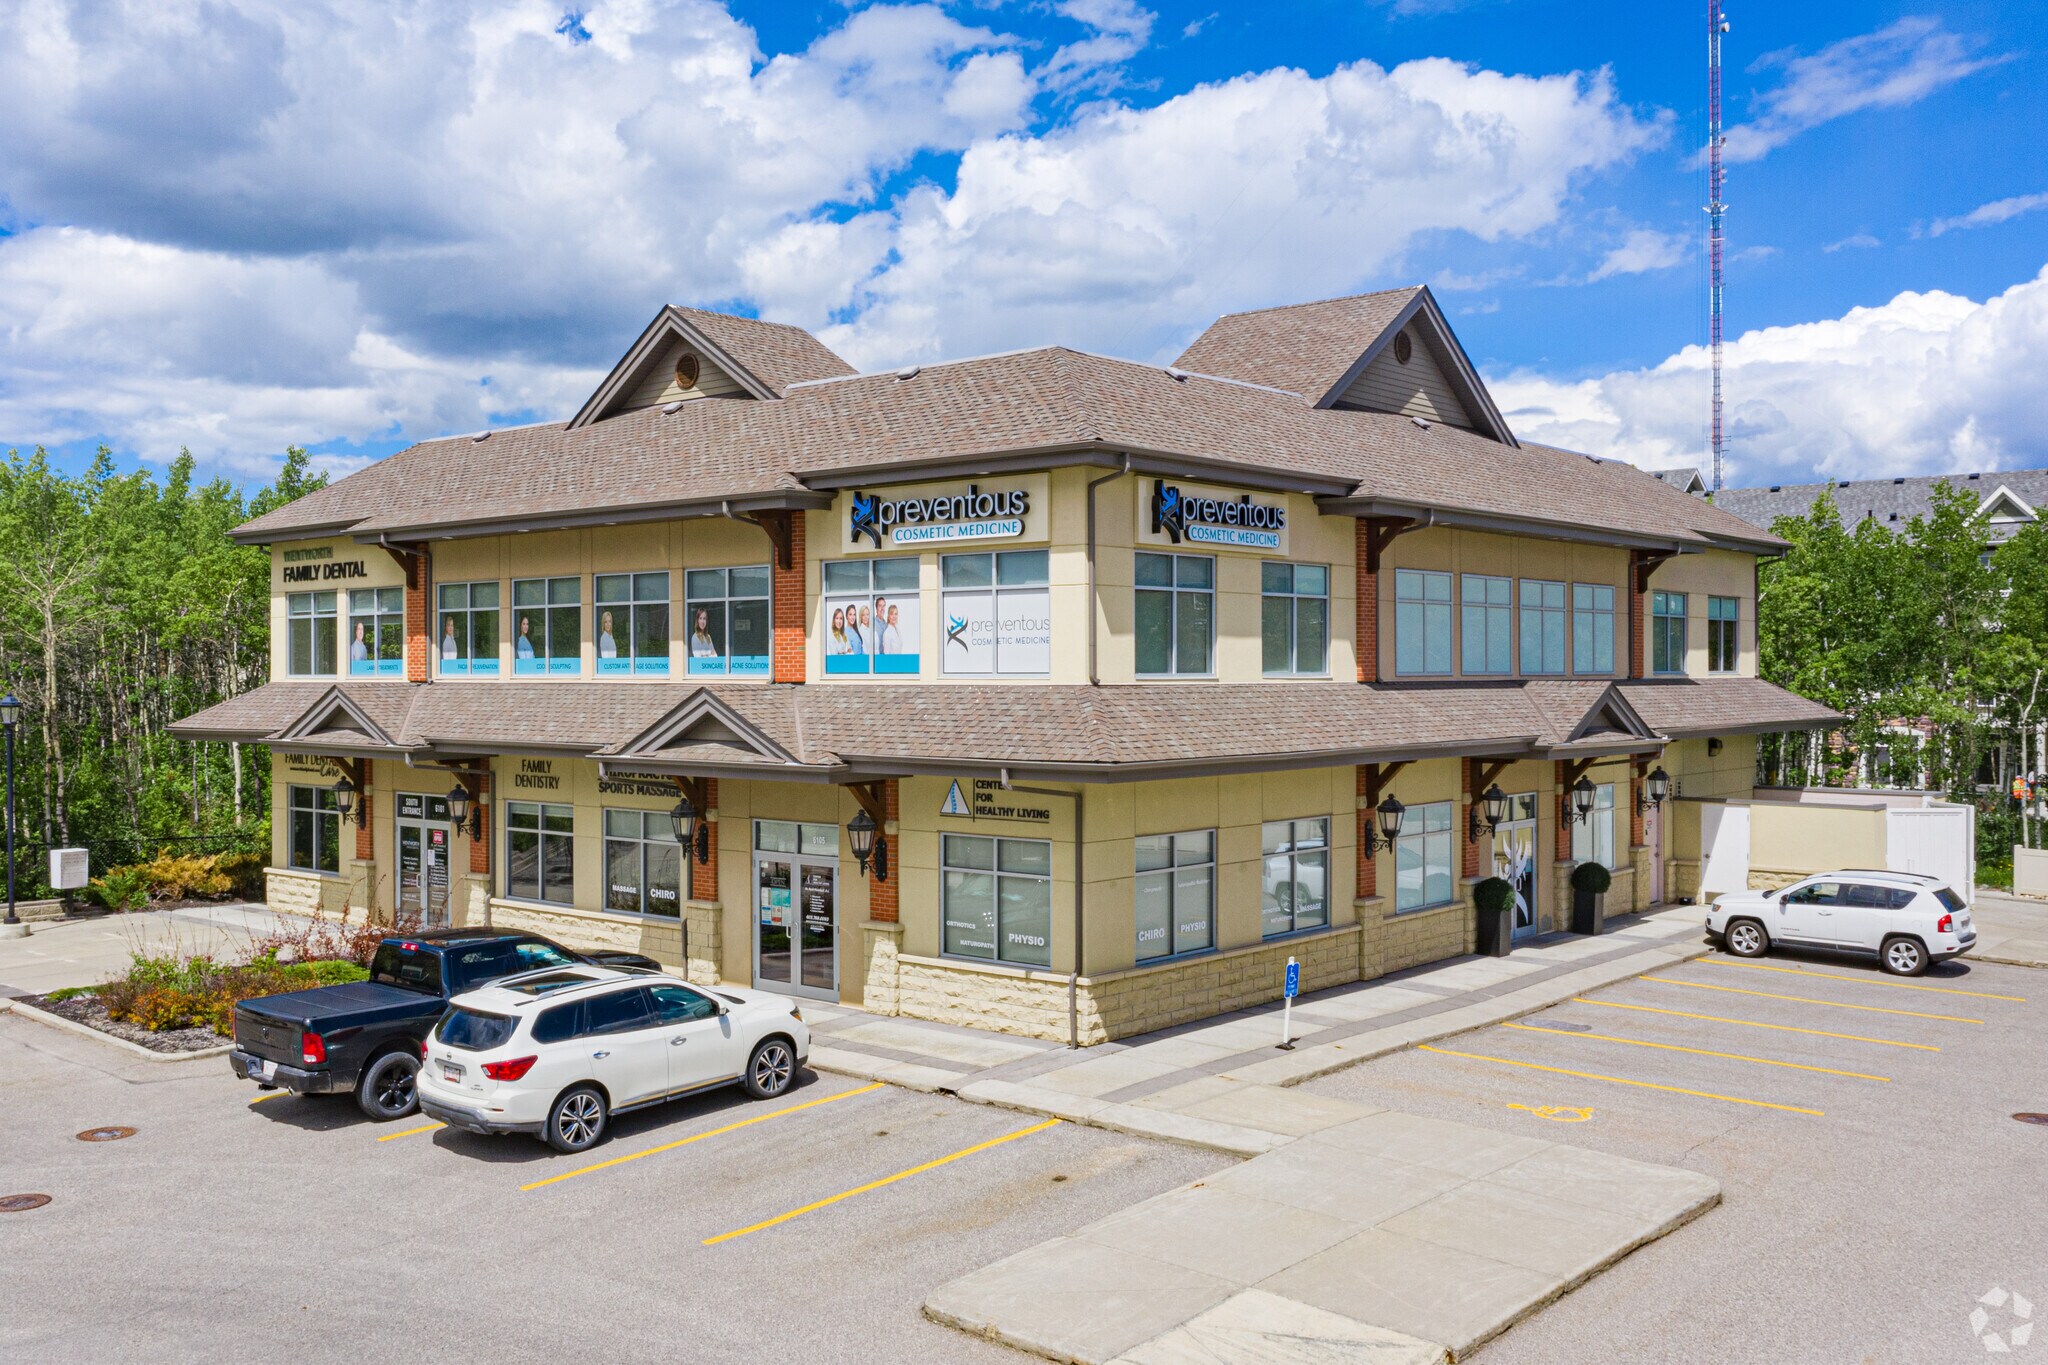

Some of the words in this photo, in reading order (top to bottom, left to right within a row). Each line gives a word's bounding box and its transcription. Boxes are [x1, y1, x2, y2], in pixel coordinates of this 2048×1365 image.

[879, 485, 1027, 528] preventous
[1183, 494, 1287, 530] preventous
[895, 526, 955, 542] COSMETIC
[958, 521, 1019, 537] MEDICINE
[1191, 526, 1236, 543] COSMETIC
[1237, 531, 1278, 546] MEDICINE
[283, 564, 321, 583] FAMILY
[323, 561, 368, 580] DENTAL
[971, 614, 1050, 637] preventous
[971, 637, 1012, 646] COSMETIC
[1015, 636, 1050, 645] MEDICINE
[701, 662, 723, 670] SKINCARE
[745, 662, 769, 670] SOLUTION
[284, 753, 309, 765] FAMILY
[521, 759, 552, 774] FAMILY
[515, 774, 560, 790] DENTISTRY
[975, 779, 1005, 791] CENTE
[598, 781, 635, 795] SPORTS
[636, 784, 682, 798] MASSAGE
[975, 792, 993, 802] FOR
[975, 805, 1015, 818] HEALTHY
[1017, 808, 1050, 820] LIVING
[812, 836, 826, 845] 6105
[612, 884, 637, 894] MASSAGE
[650, 888, 676, 900] CHIRO
[946, 920, 976, 930] ORTHOTICS
[1180, 920, 1206, 933] PHYSIO
[1008, 933, 1045, 947] PHYSIO
[1138, 928, 1165, 942] CHIRO
